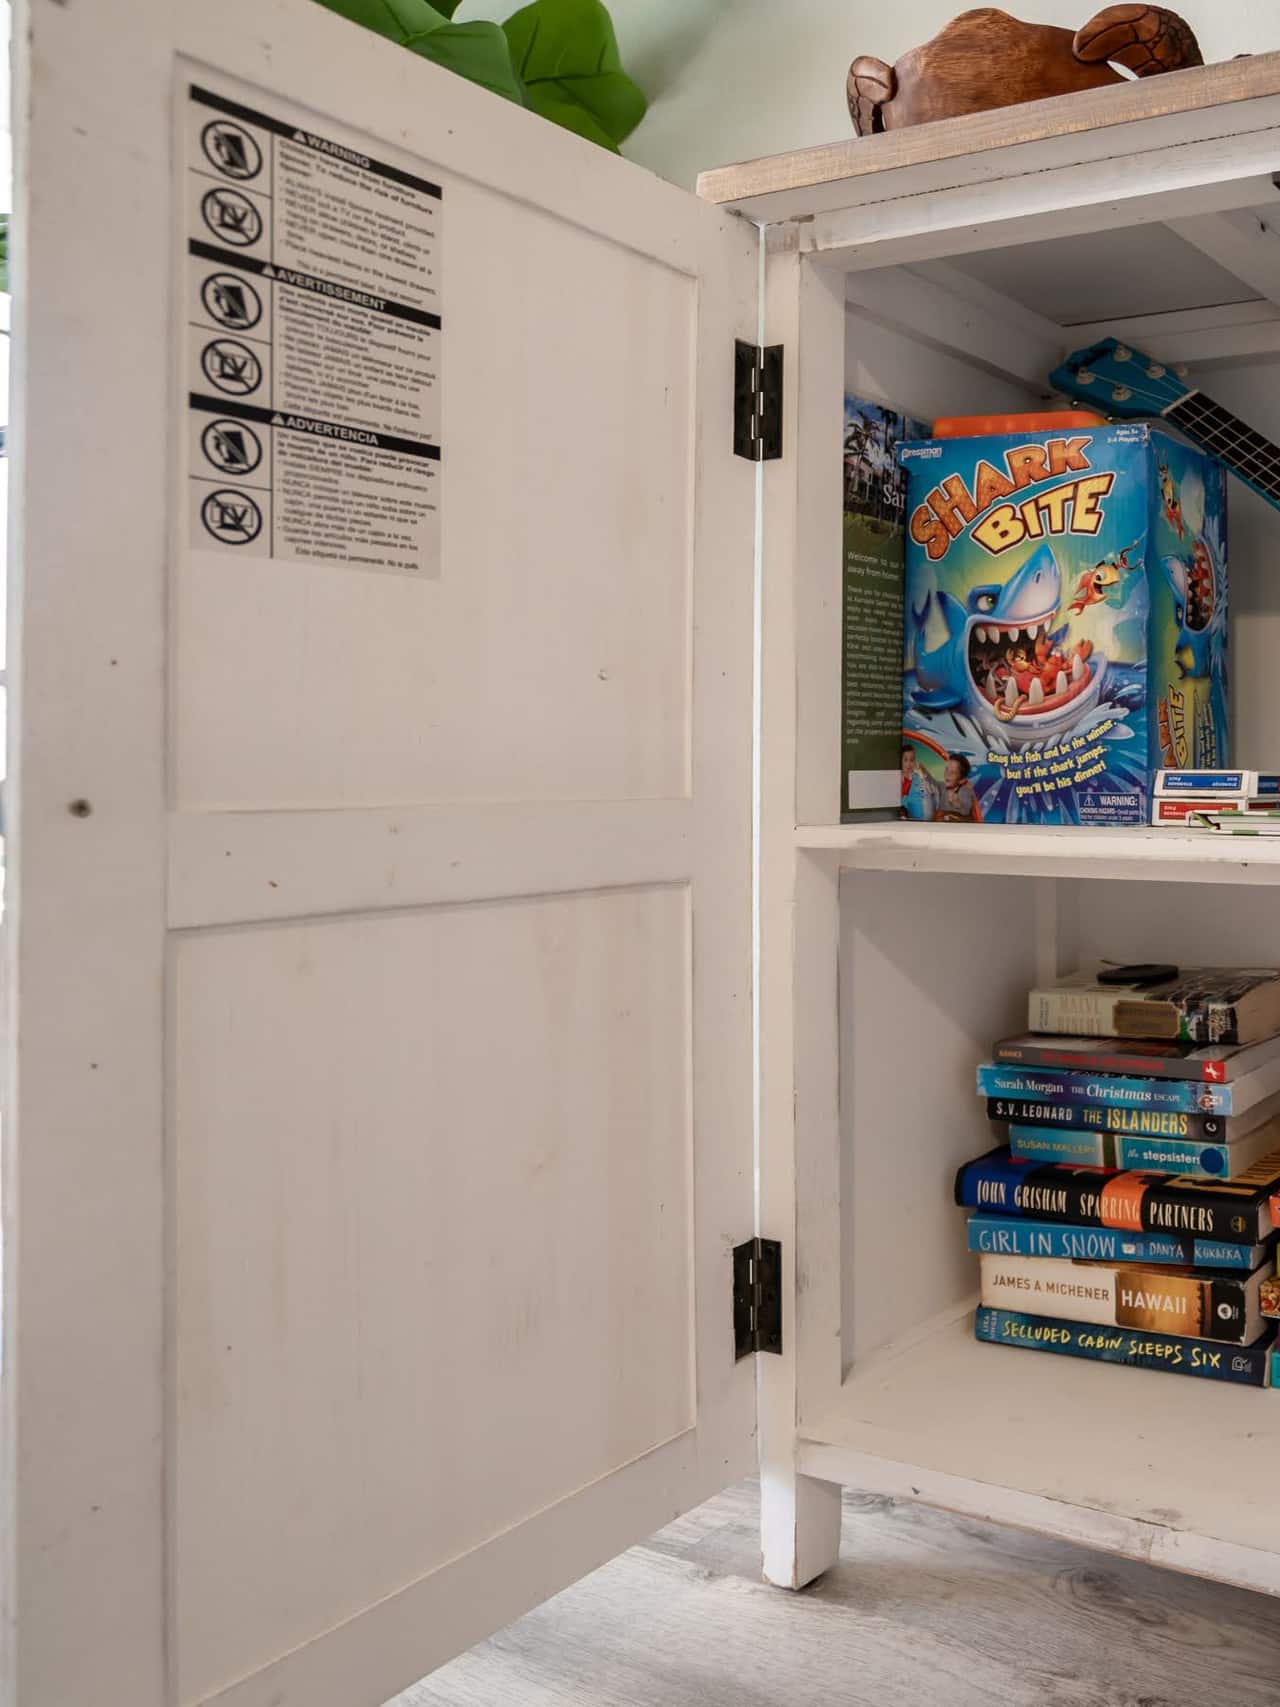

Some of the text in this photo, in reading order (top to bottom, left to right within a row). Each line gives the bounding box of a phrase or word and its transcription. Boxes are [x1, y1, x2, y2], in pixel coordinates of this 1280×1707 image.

[307, 135, 370, 167] WARNING
[279, 269, 387, 311] AVERTISSEMENT
[285, 418, 379, 445] ADVERTENCIA
[911, 436, 1092, 560] SHARK
[970, 472, 1116, 556] BITE
[1168, 683, 1188, 768] BITE
[988, 751, 1009, 766] Snag
[1010, 753, 1023, 764] the
[1025, 751, 1041, 762] fish
[1043, 748, 1058, 759] and
[1059, 744, 1070, 755] be
[1071, 737, 1086, 749] the
[1006, 768, 1021, 780] but
[1024, 767, 1032, 779] if
[1033, 766, 1048, 777] the
[1051, 758, 1075, 774] shark
[1016, 781, 1041, 798] you'll
[1044, 780, 1056, 792] be
[1056, 777, 1073, 789] his
[1100, 795, 1138, 806] WARNING:
[994, 1077, 1064, 1095] Sarah Morgan
[1086, 1083, 1151, 1101] Christmas
[996, 1101, 1073, 1121] S.V. LEONARD
[1083, 1109, 1188, 1135] THE ISLANDERS
[1017, 1139, 1049, 1150] SUSAN
[977, 1180, 1067, 1213] JOHN GRISHAM
[1080, 1194, 1214, 1232] SPARRING PARTNERS
[979, 1229, 1115, 1257] GIRL IN SNOW
[1149, 1242, 1184, 1259] DANYA
[992, 1274, 1109, 1301] JAMES A MICHENER
[1122, 1289, 1187, 1314] HAWAII
[1003, 1320, 1221, 1368] SECLUDED CABIN SLEEPS SIX
